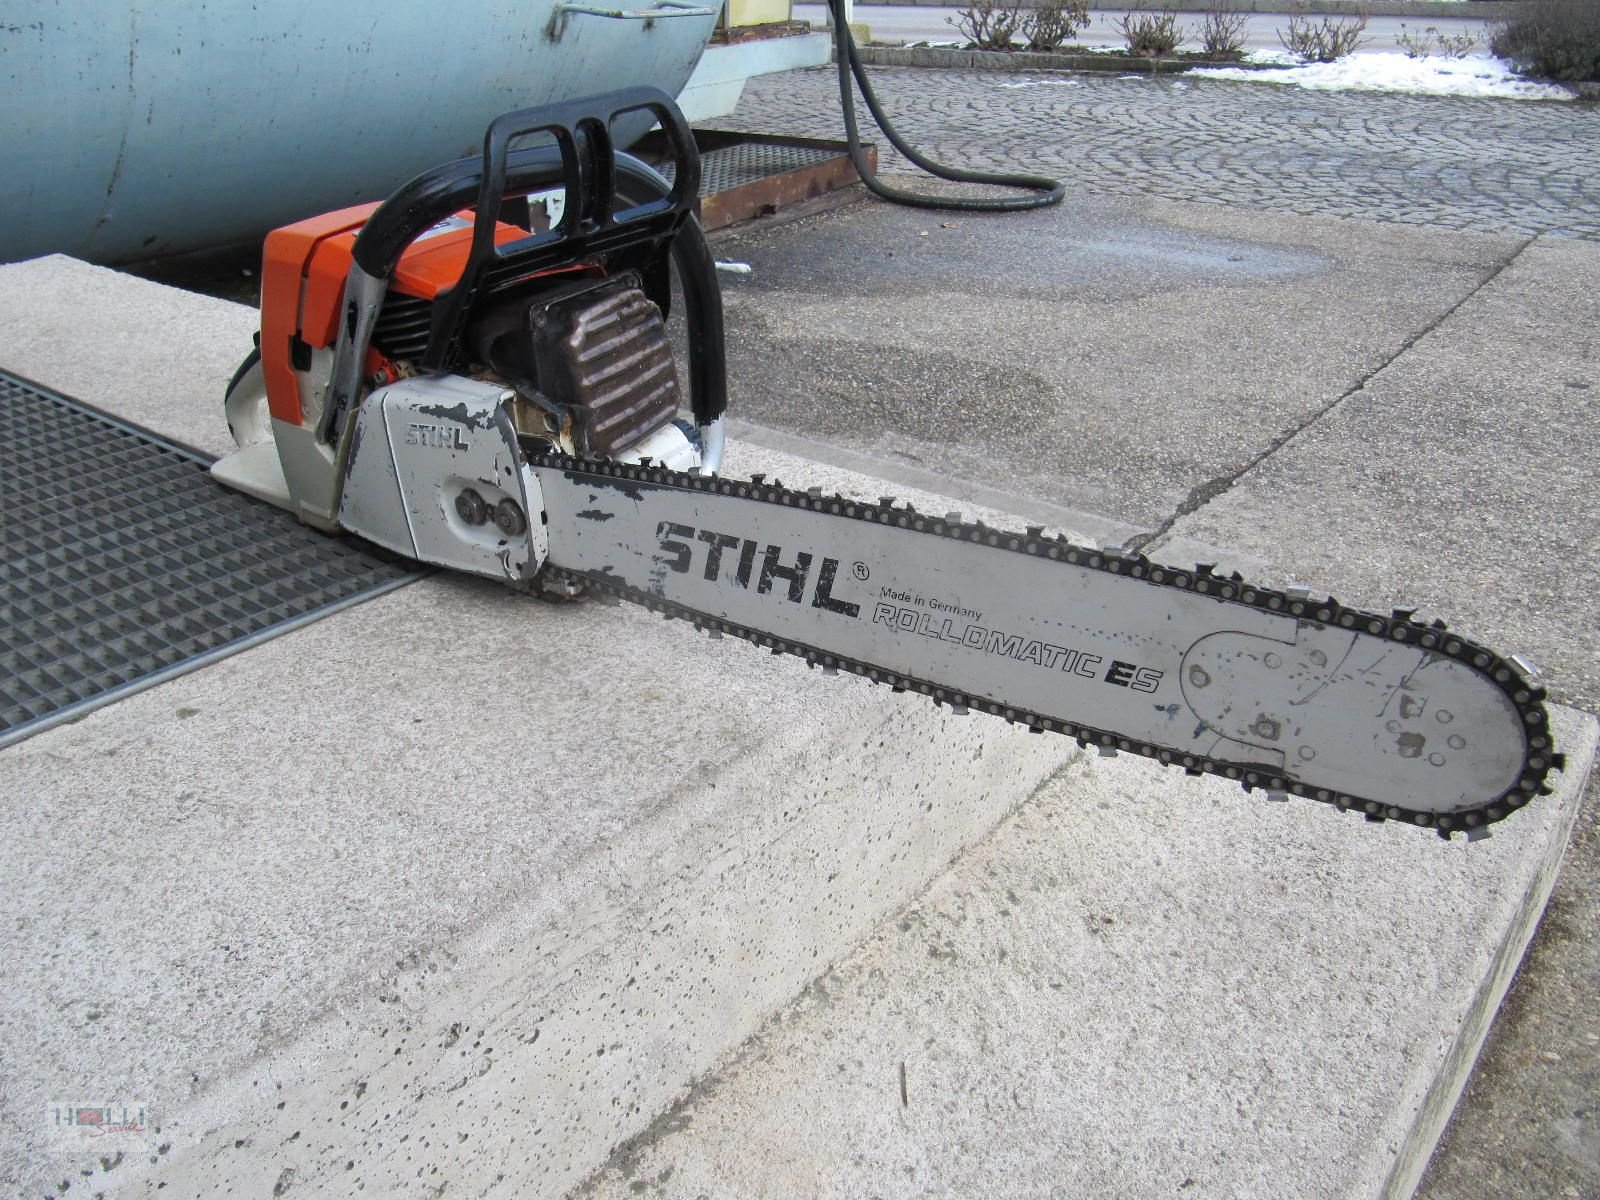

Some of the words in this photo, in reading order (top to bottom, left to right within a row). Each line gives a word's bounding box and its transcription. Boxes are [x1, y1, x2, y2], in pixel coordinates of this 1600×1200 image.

[406, 423, 470, 450] STIHL
[650, 521, 861, 618] STIHL
[881, 586, 911, 602] Made
[914, 594, 925, 606] in
[929, 598, 982, 621] Germany
[873, 602, 1102, 679] ROLLOMATIC
[1104, 660, 1164, 693] ES
